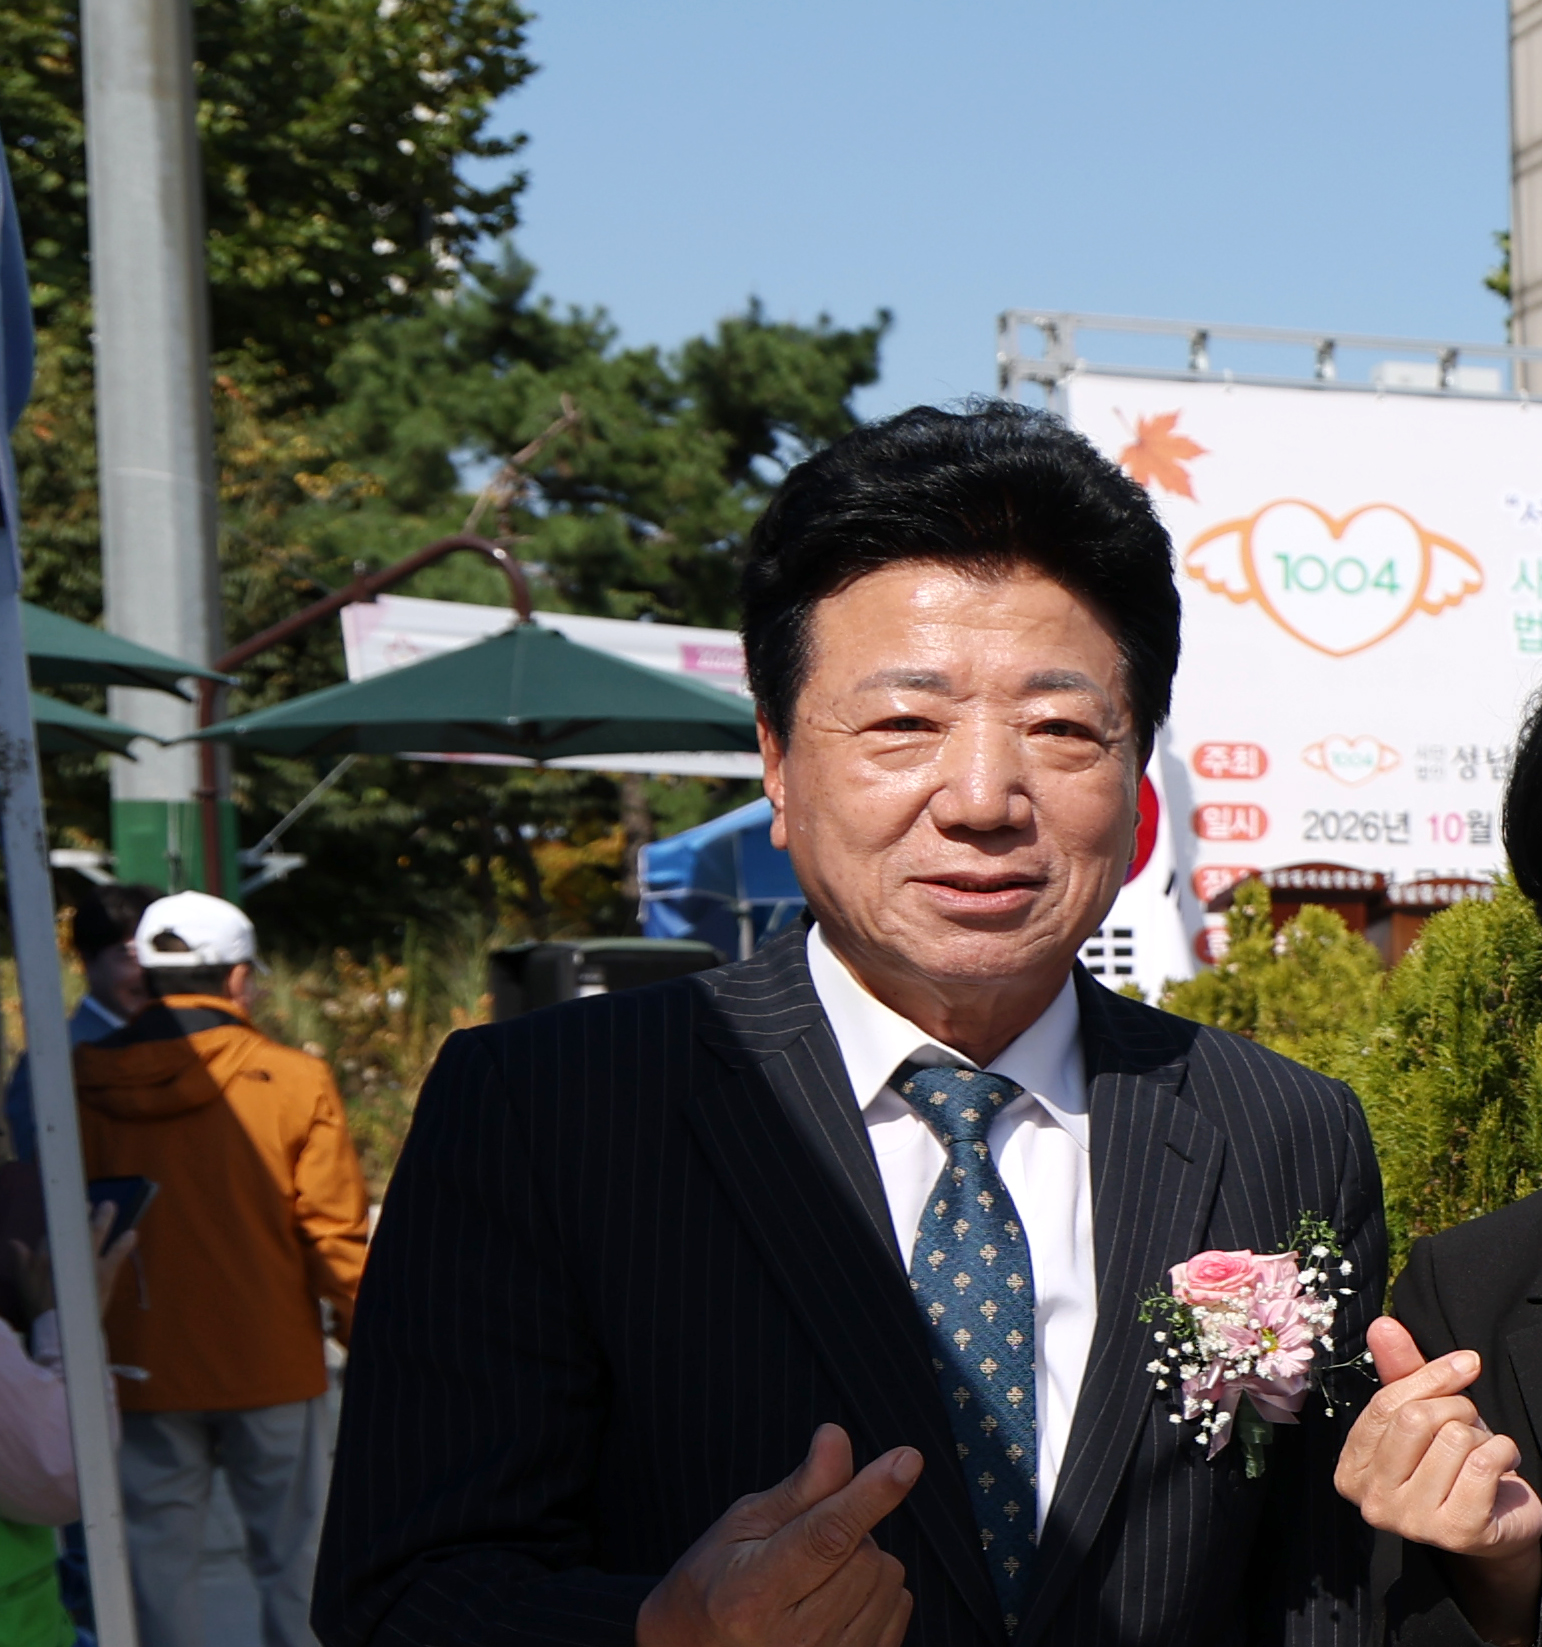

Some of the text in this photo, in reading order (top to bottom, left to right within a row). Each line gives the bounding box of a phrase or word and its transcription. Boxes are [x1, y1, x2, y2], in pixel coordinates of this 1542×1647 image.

[1275, 553, 1402, 597] 1004
[1202, 745, 1260, 774] 주최
[1203, 805, 1492, 844] 일시 2026년 10월
